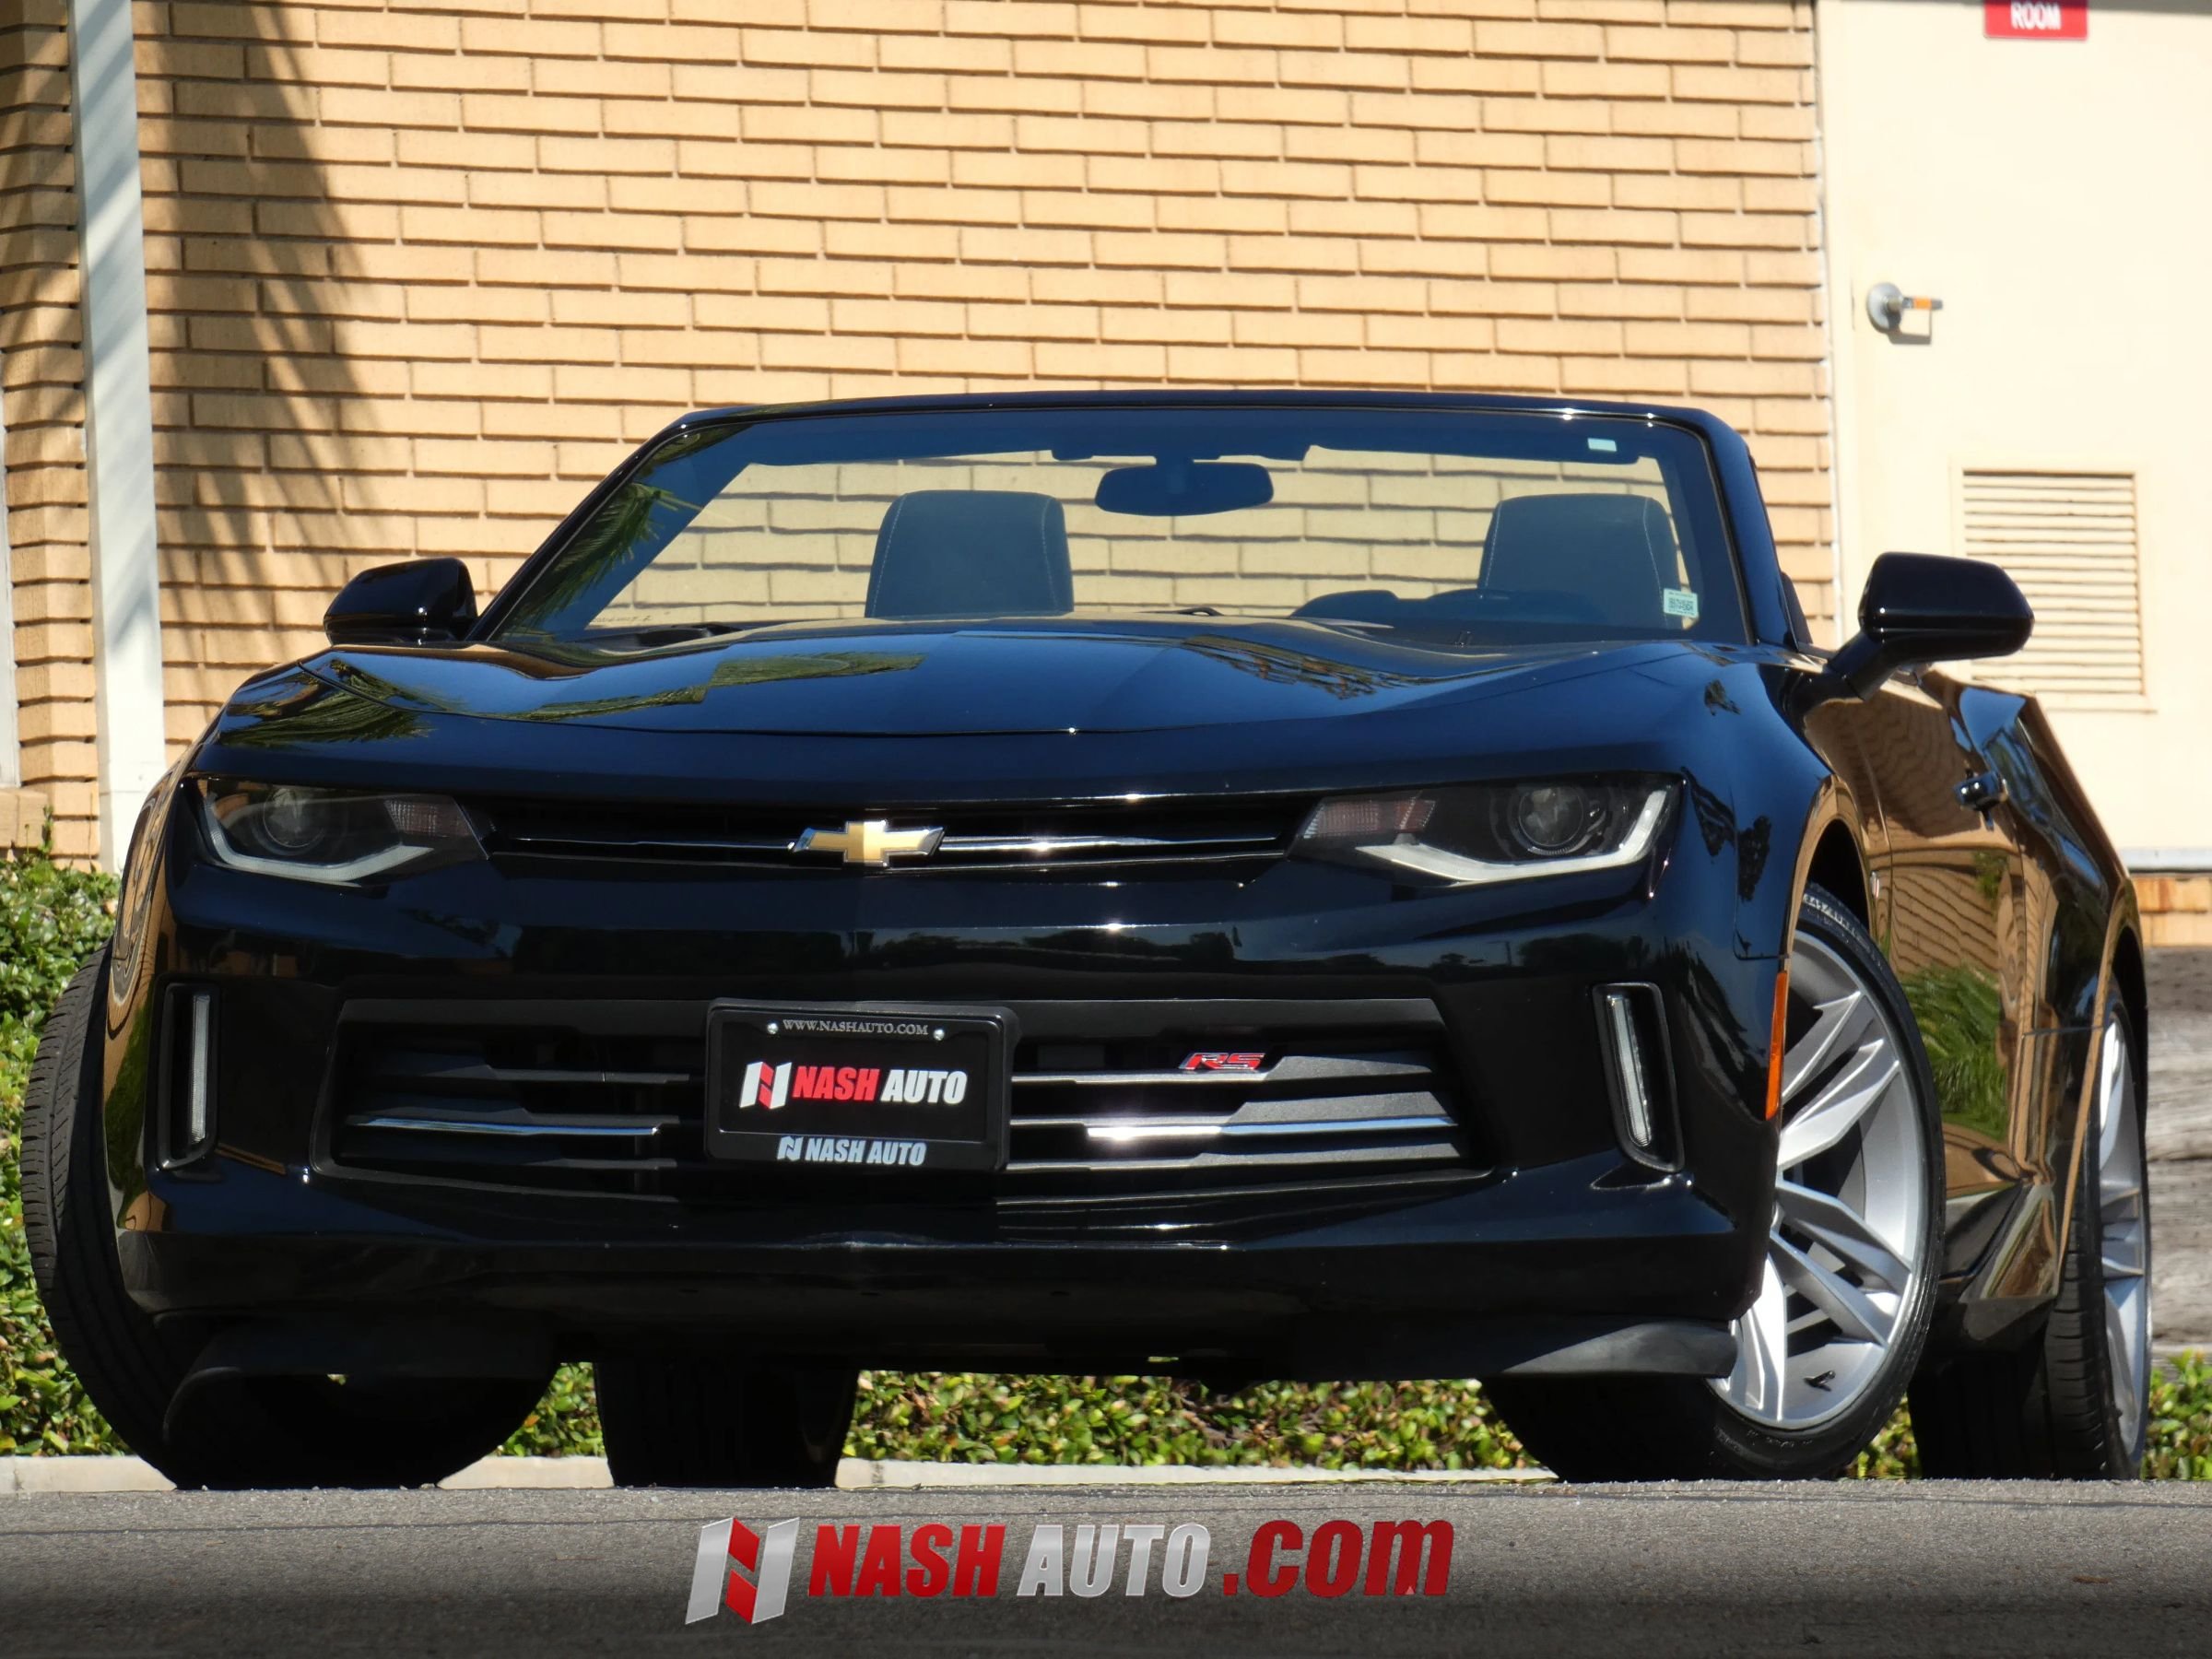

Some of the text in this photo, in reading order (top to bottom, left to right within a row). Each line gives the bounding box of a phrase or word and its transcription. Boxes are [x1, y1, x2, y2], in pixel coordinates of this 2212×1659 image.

[2010, 1, 2062, 29] ROOM
[783, 1019, 929, 1035] WWW.NASHAUTO.COM
[1179, 1053, 1265, 1070] RS
[793, 1066, 880, 1101] NASH
[880, 1069, 967, 1104] AUTO
[805, 1137, 863, 1162] NASH
[866, 1141, 927, 1166] AUTO
